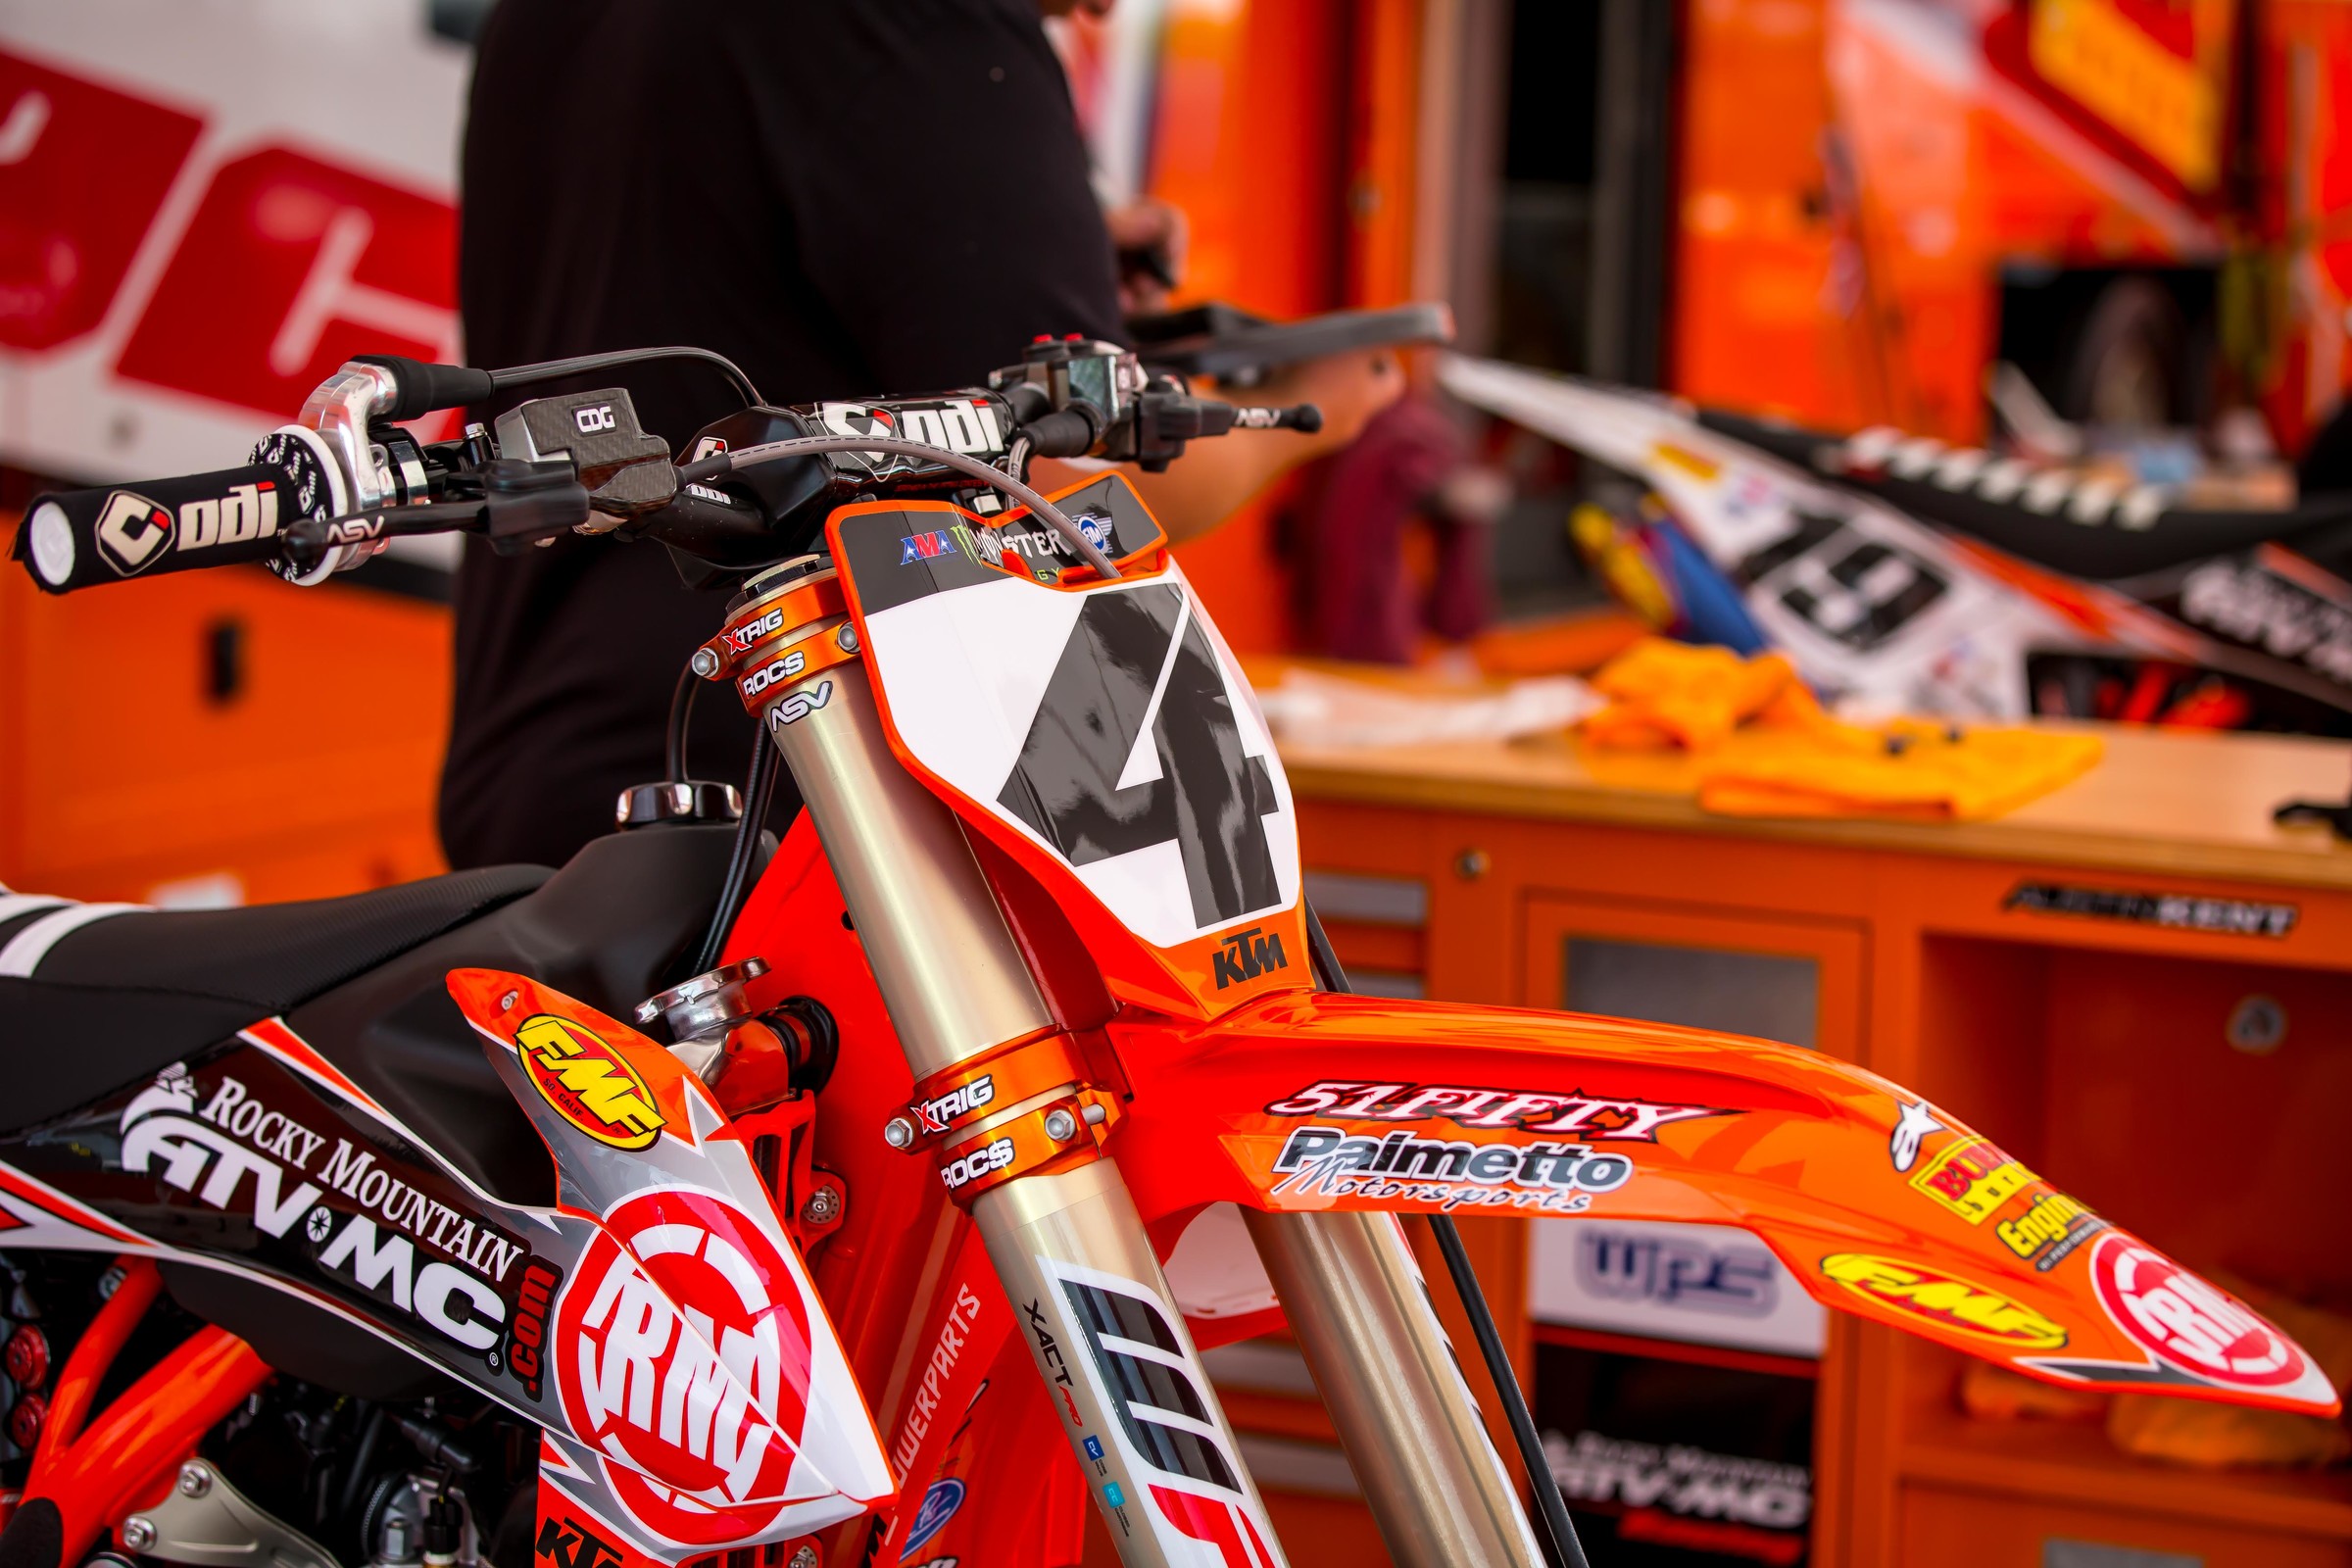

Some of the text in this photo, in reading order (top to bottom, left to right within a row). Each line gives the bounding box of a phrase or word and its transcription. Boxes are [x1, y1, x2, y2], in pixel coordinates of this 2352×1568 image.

[327, 515, 384, 543] ASV
[900, 530, 957, 565] AMA
[722, 608, 784, 656] XTRIG
[742, 651, 806, 701] ROCS
[770, 680, 833, 733] ASV
[996, 582, 1280, 930] 4
[1211, 927, 1288, 991] KTM
[513, 1020, 668, 1137] FMF
[910, 1074, 995, 1135] XTRIG
[1265, 1080, 1735, 1144] 51FIFTY
[940, 1137, 1015, 1192] ROCS
[1271, 1127, 1633, 1193] Palmetto
[1271, 1156, 1592, 1213] Motorsports
[1822, 1254, 2067, 1341] FMF
[1022, 1298, 1073, 1387] XACT
[892, 1283, 980, 1490] OWERPARTS
